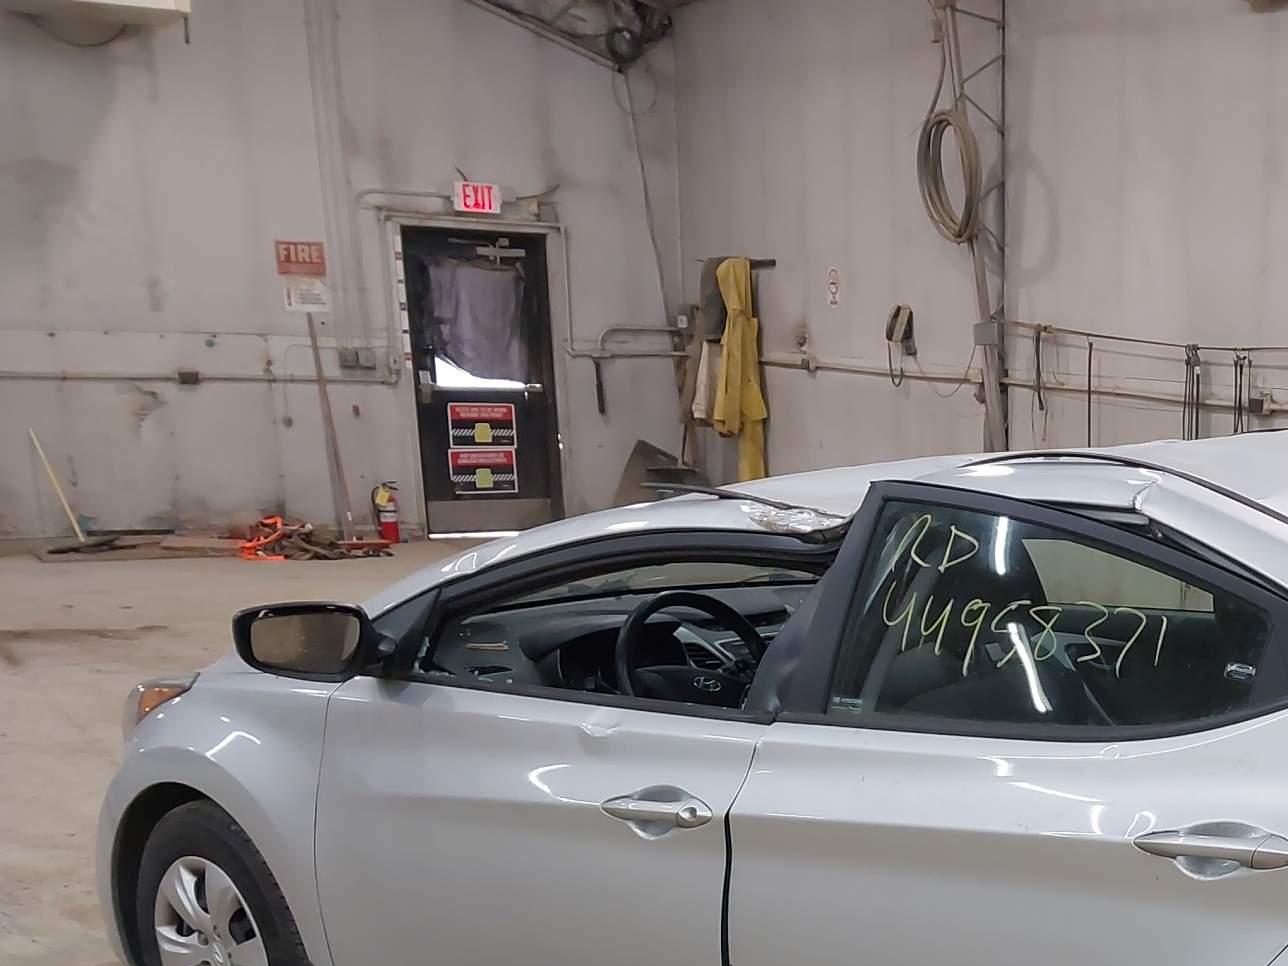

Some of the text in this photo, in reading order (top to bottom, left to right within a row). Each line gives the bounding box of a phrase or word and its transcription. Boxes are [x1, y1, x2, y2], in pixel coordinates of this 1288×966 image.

[462, 183, 493, 210] EXIT
[278, 243, 323, 263] FIRE
[882, 579, 1168, 679] 44958371
